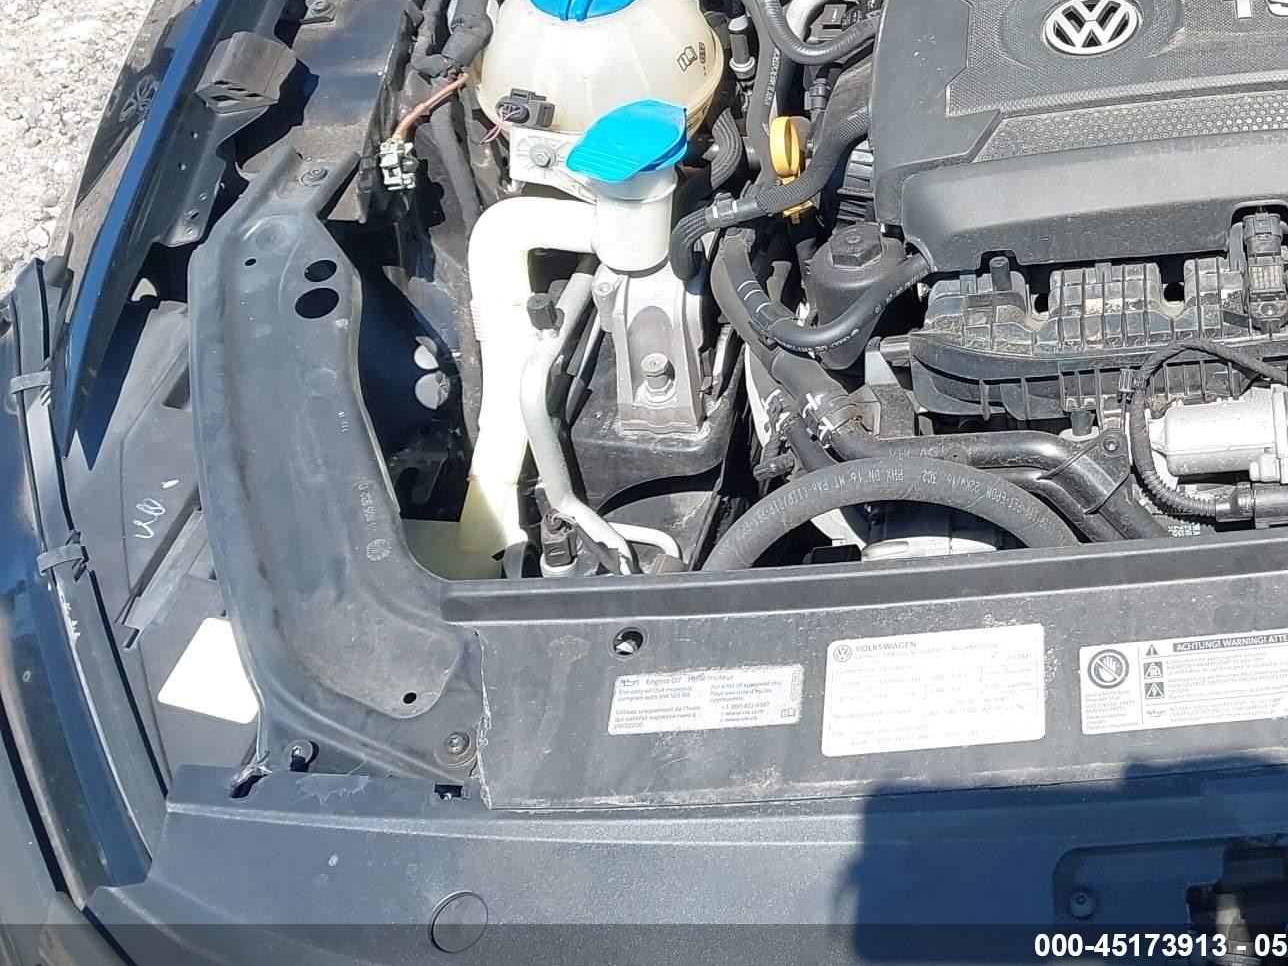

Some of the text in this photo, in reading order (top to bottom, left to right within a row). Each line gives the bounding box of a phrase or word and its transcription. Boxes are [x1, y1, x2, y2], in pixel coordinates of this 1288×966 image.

[856, 642, 916, 652] VOLKSWAGEN
[1176, 642, 1220, 651] ACHTUNG!
[1222, 636, 1266, 646] WARNING!
[646, 678, 670, 686] Engine
